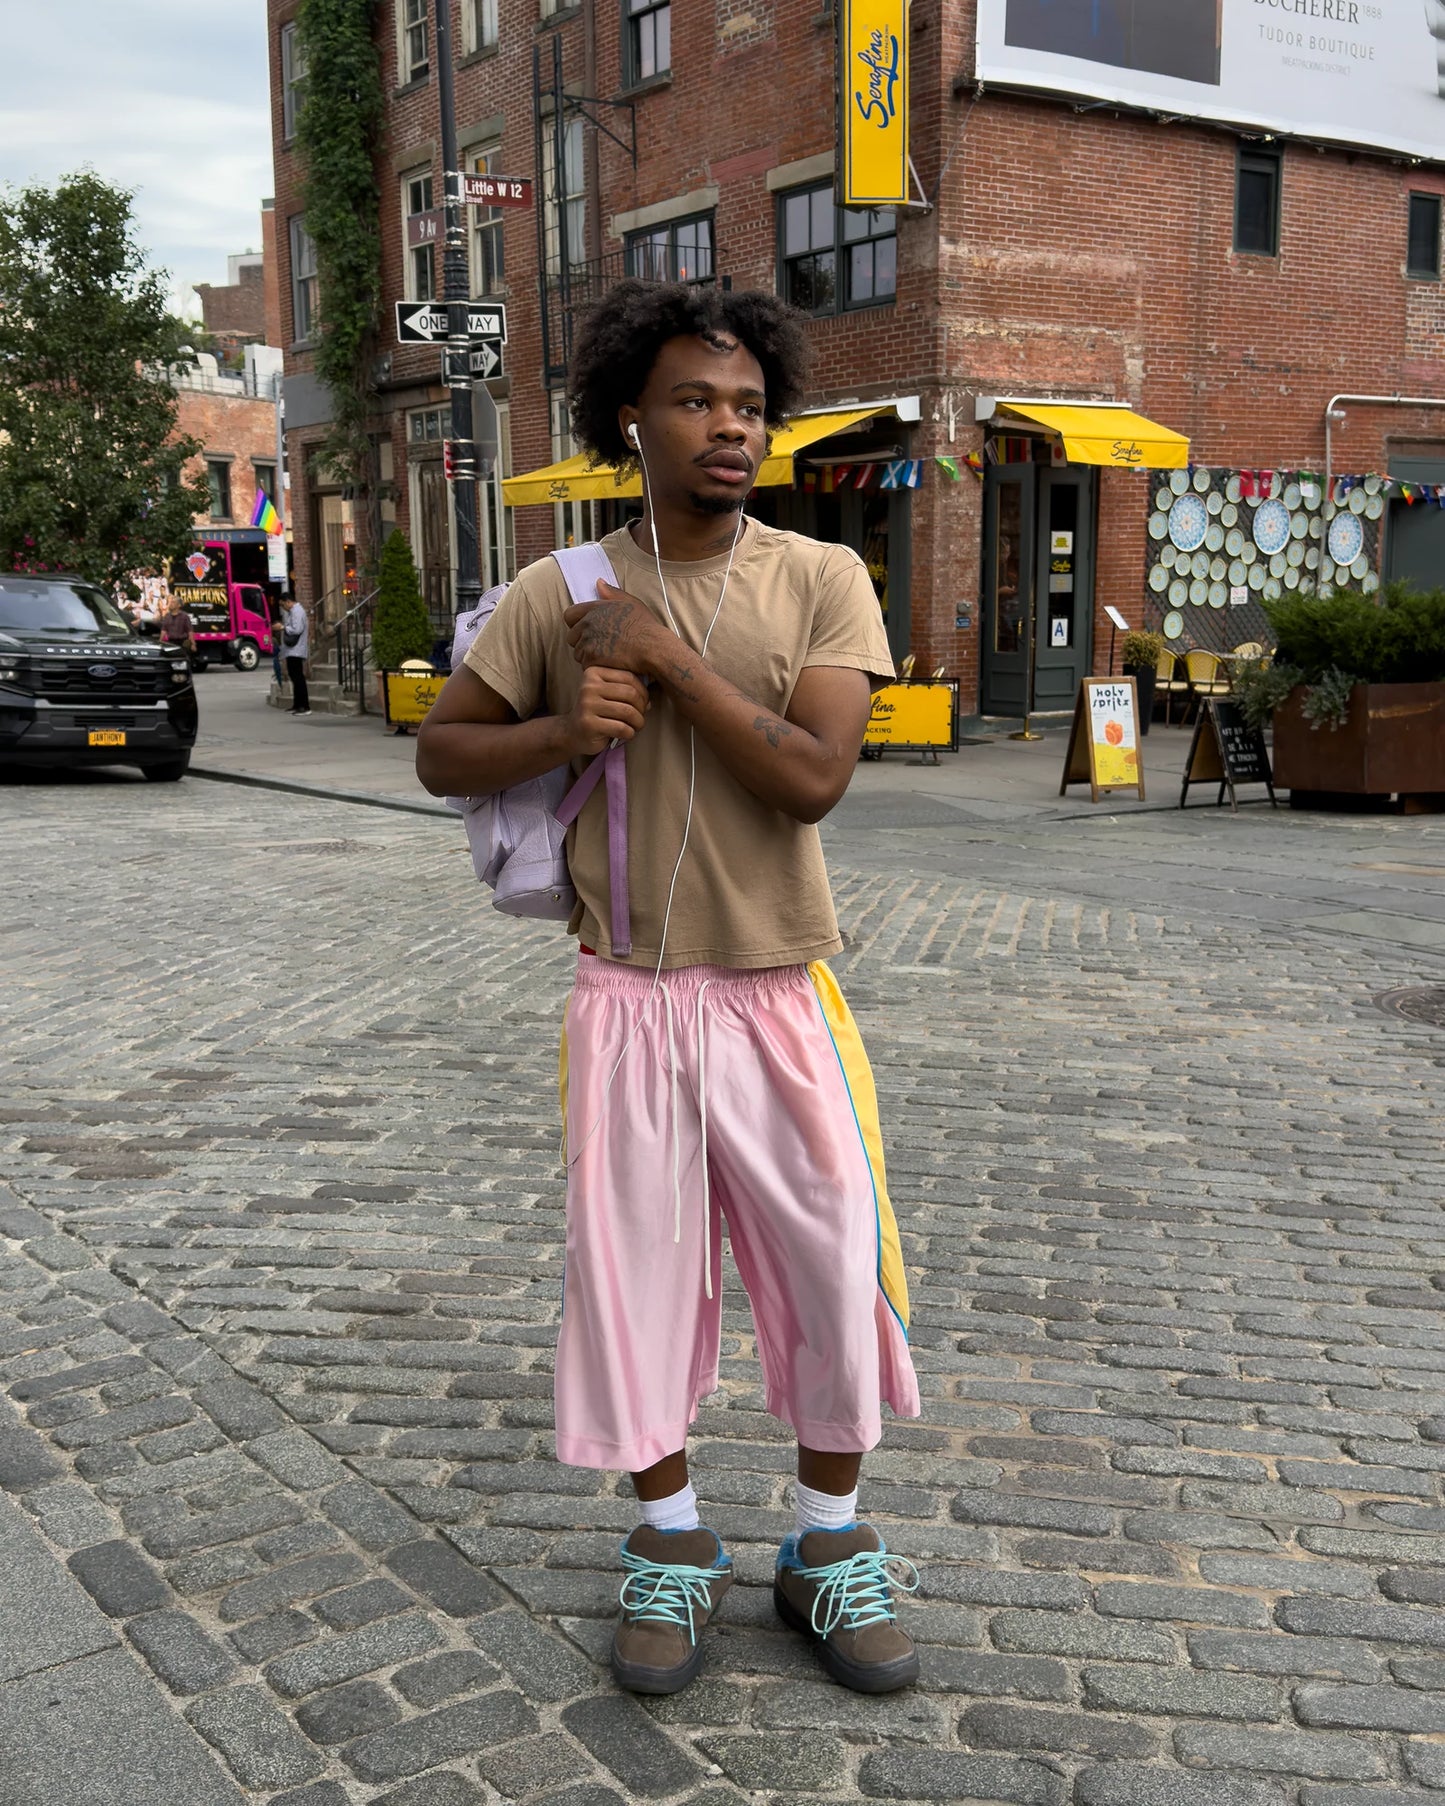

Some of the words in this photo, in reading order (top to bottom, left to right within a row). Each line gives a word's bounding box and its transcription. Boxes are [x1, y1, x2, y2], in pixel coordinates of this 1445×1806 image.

[1254, 0, 1359, 24] CHERER
[1258, 24, 1303, 47] TUDOR
[1309, 35, 1375, 61] BOUTIQUE
[856, 29, 899, 128] Serafina
[465, 179, 494, 196] Little
[497, 183, 507, 197] W
[511, 184, 522, 198] 12
[419, 220, 425, 238] 9
[427, 218, 437, 237] Av
[419, 315, 448, 330] ONE
[472, 352, 490, 370] WAY
[174, 586, 228, 605] CHAMPIONS
[1054, 621, 1064, 637] A
